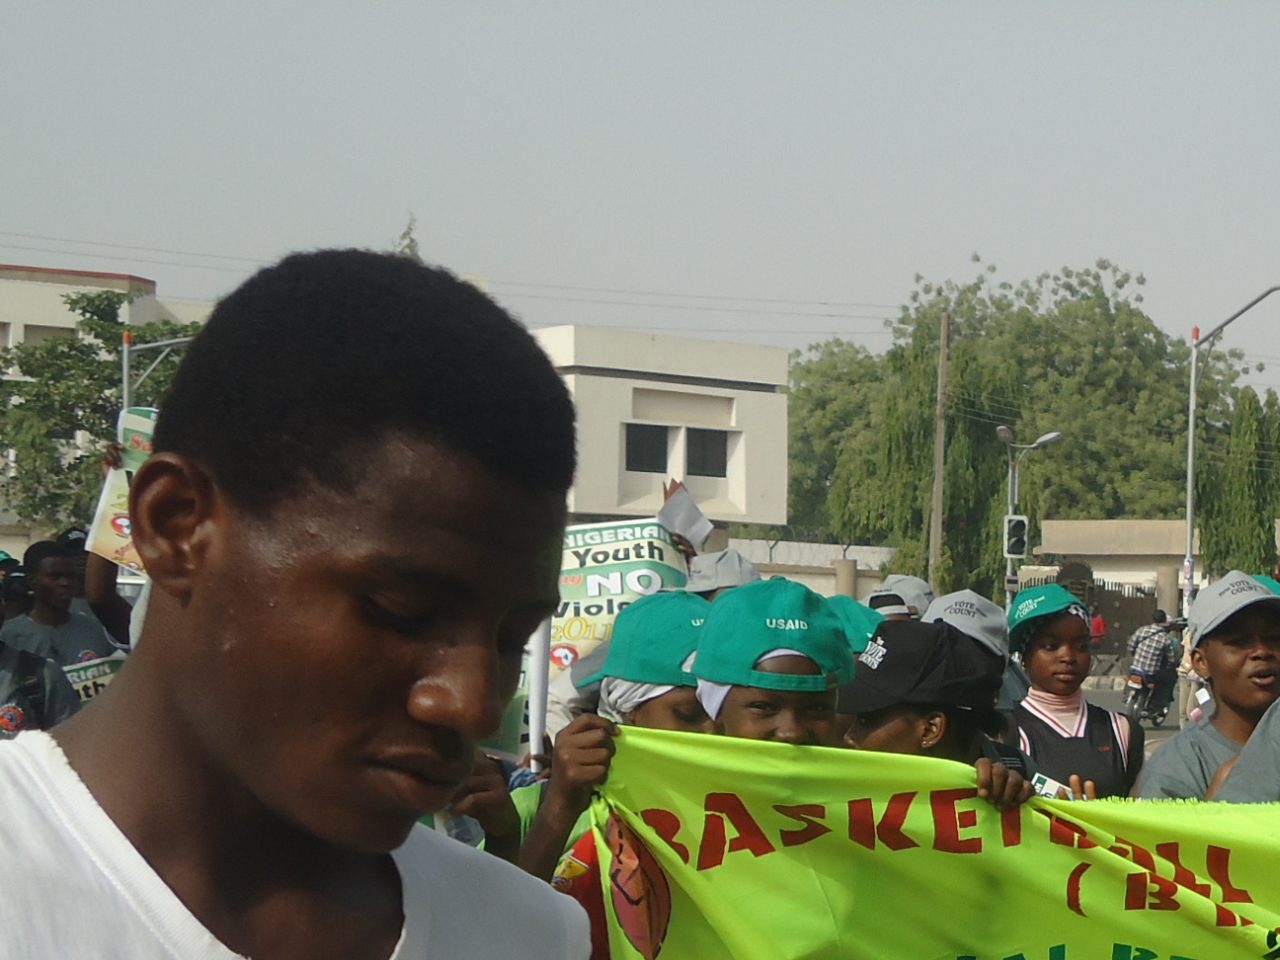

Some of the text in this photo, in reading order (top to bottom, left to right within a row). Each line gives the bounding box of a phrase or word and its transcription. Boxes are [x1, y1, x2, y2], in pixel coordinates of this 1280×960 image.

[571, 541, 665, 568] Youth
[585, 568, 663, 598] NO
[552, 598, 634, 619] Viol
[765, 618, 809, 631] USAID
[66, 663, 111, 685] RIAN
